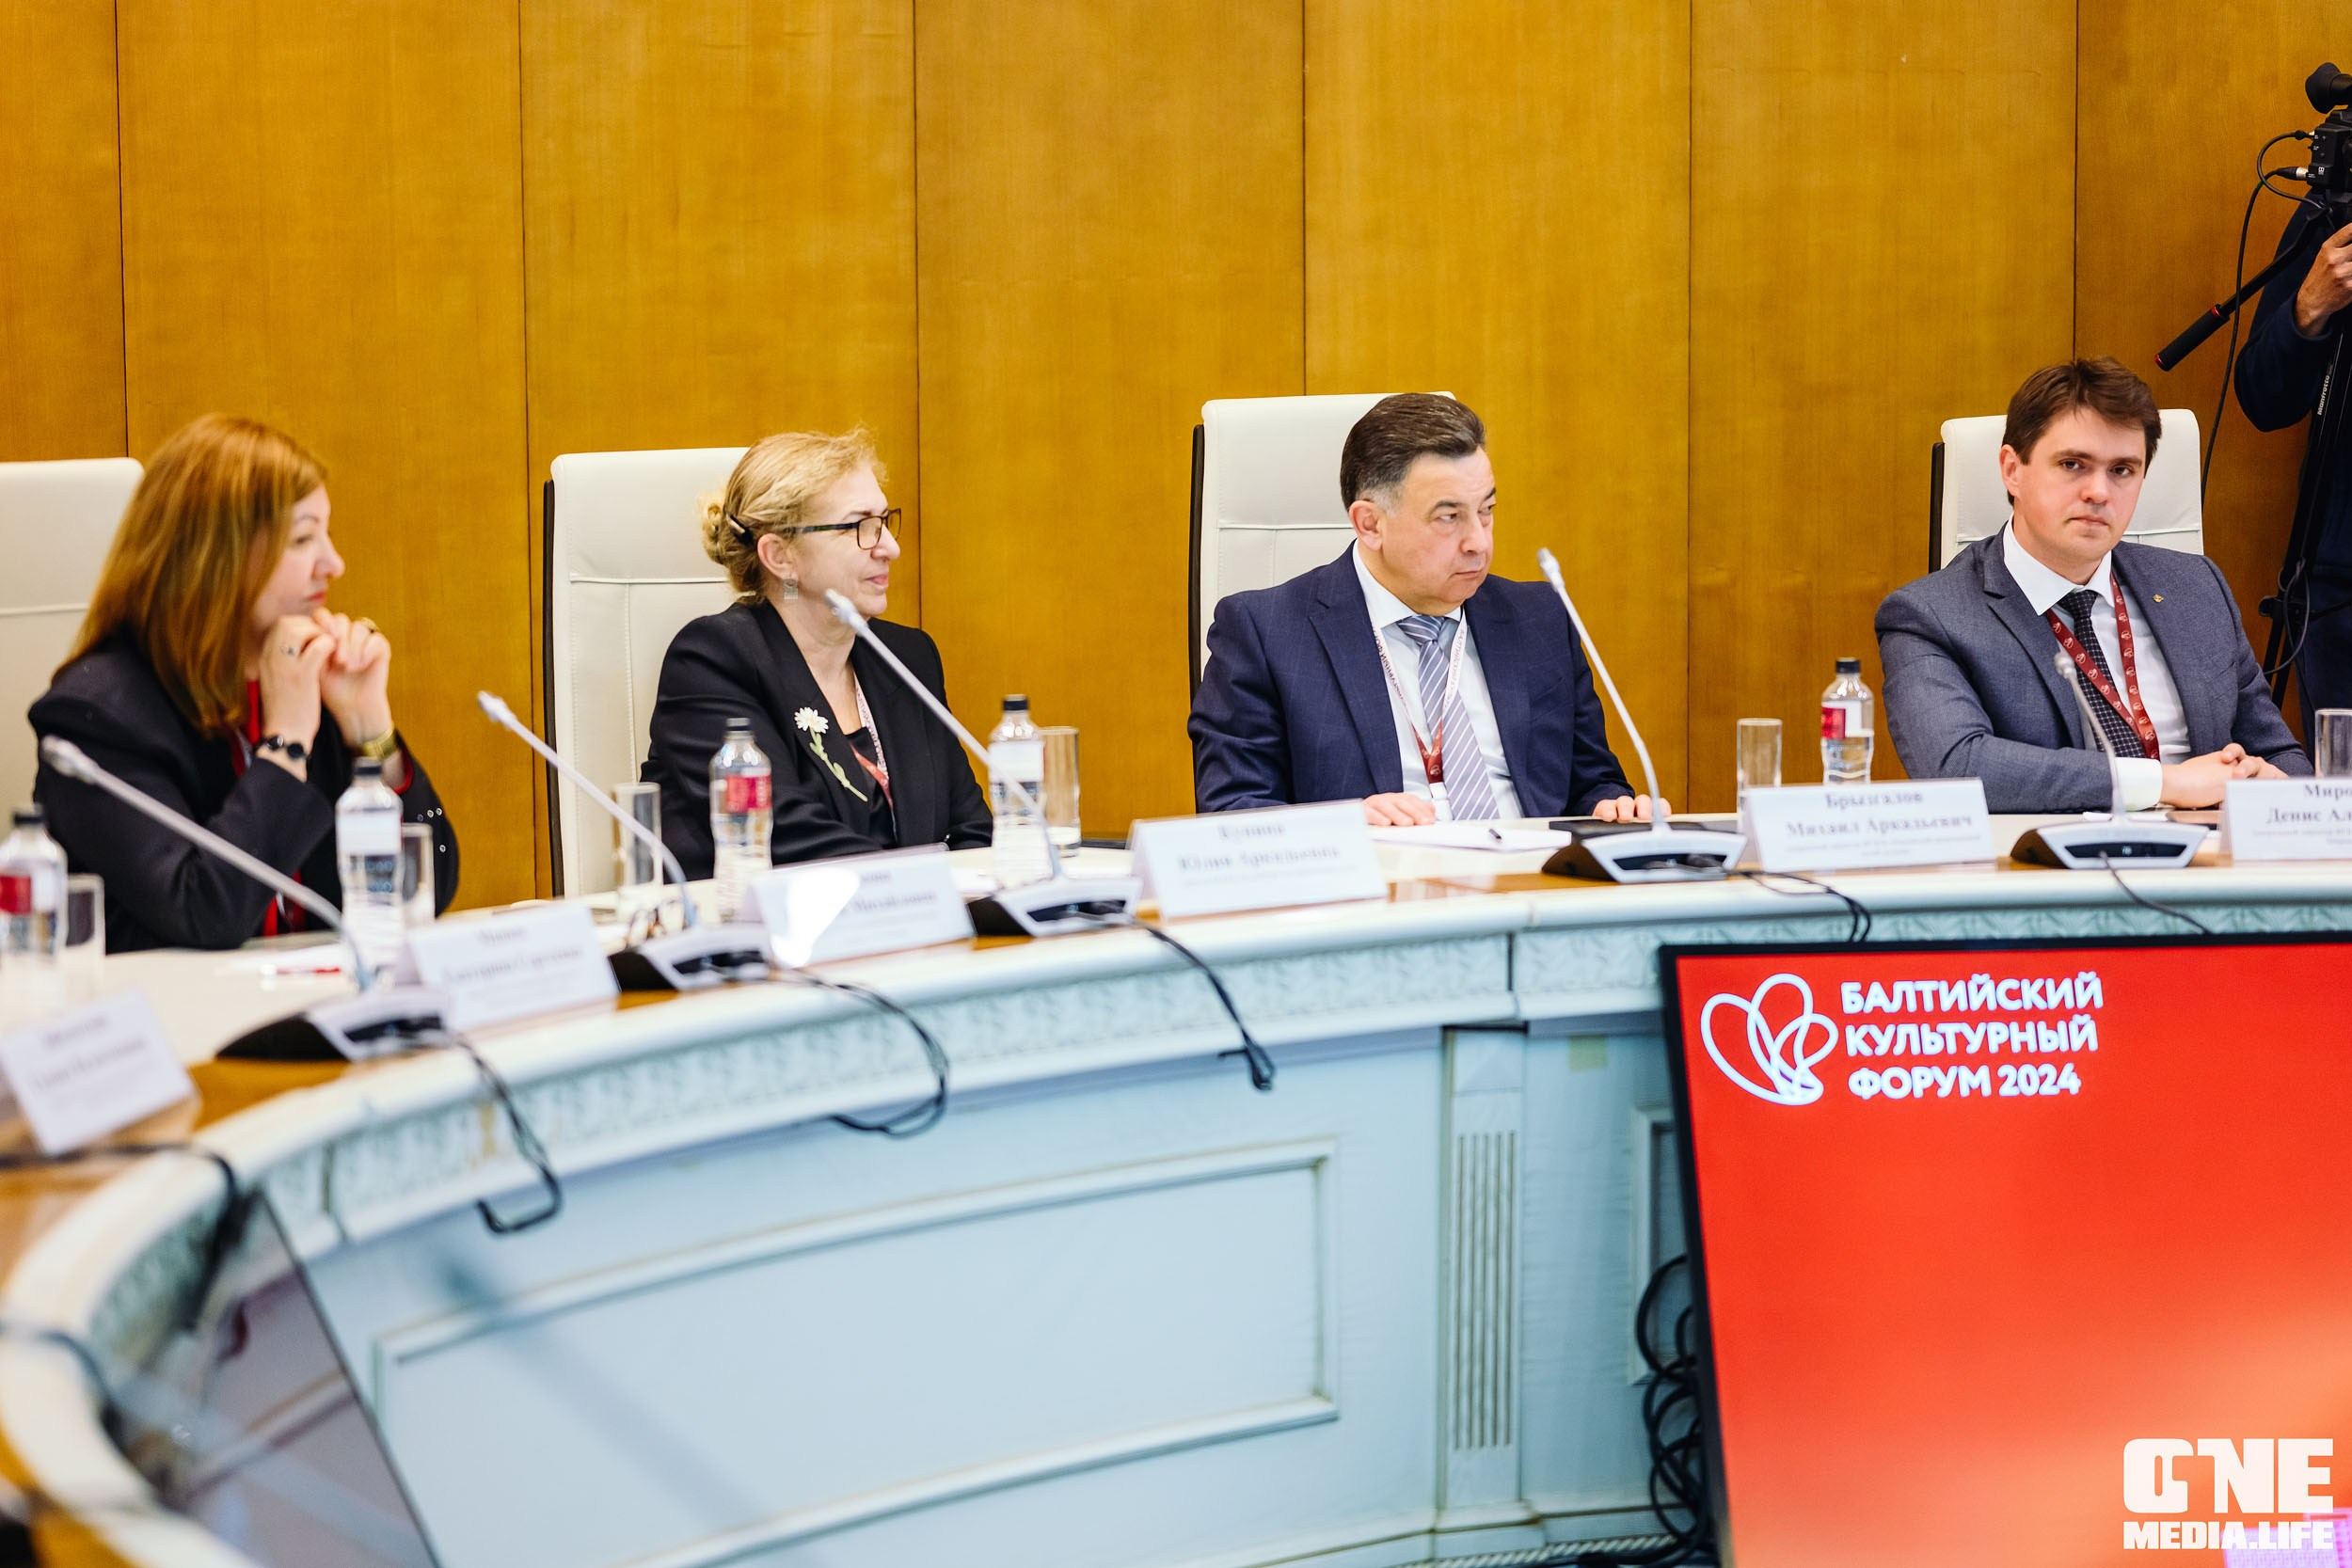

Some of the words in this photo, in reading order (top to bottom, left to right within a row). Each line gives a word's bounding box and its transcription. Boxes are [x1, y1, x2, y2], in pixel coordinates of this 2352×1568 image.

[2265, 806, 2321, 824] Денис
[1840, 971, 2105, 1014] БАЛТИЙСКИЙ
[1845, 1013, 2099, 1057] КУЛЬТУРНЫЙ
[1848, 1063, 1993, 1101] ФОРУМ
[1996, 1062, 2082, 1098] 2024
